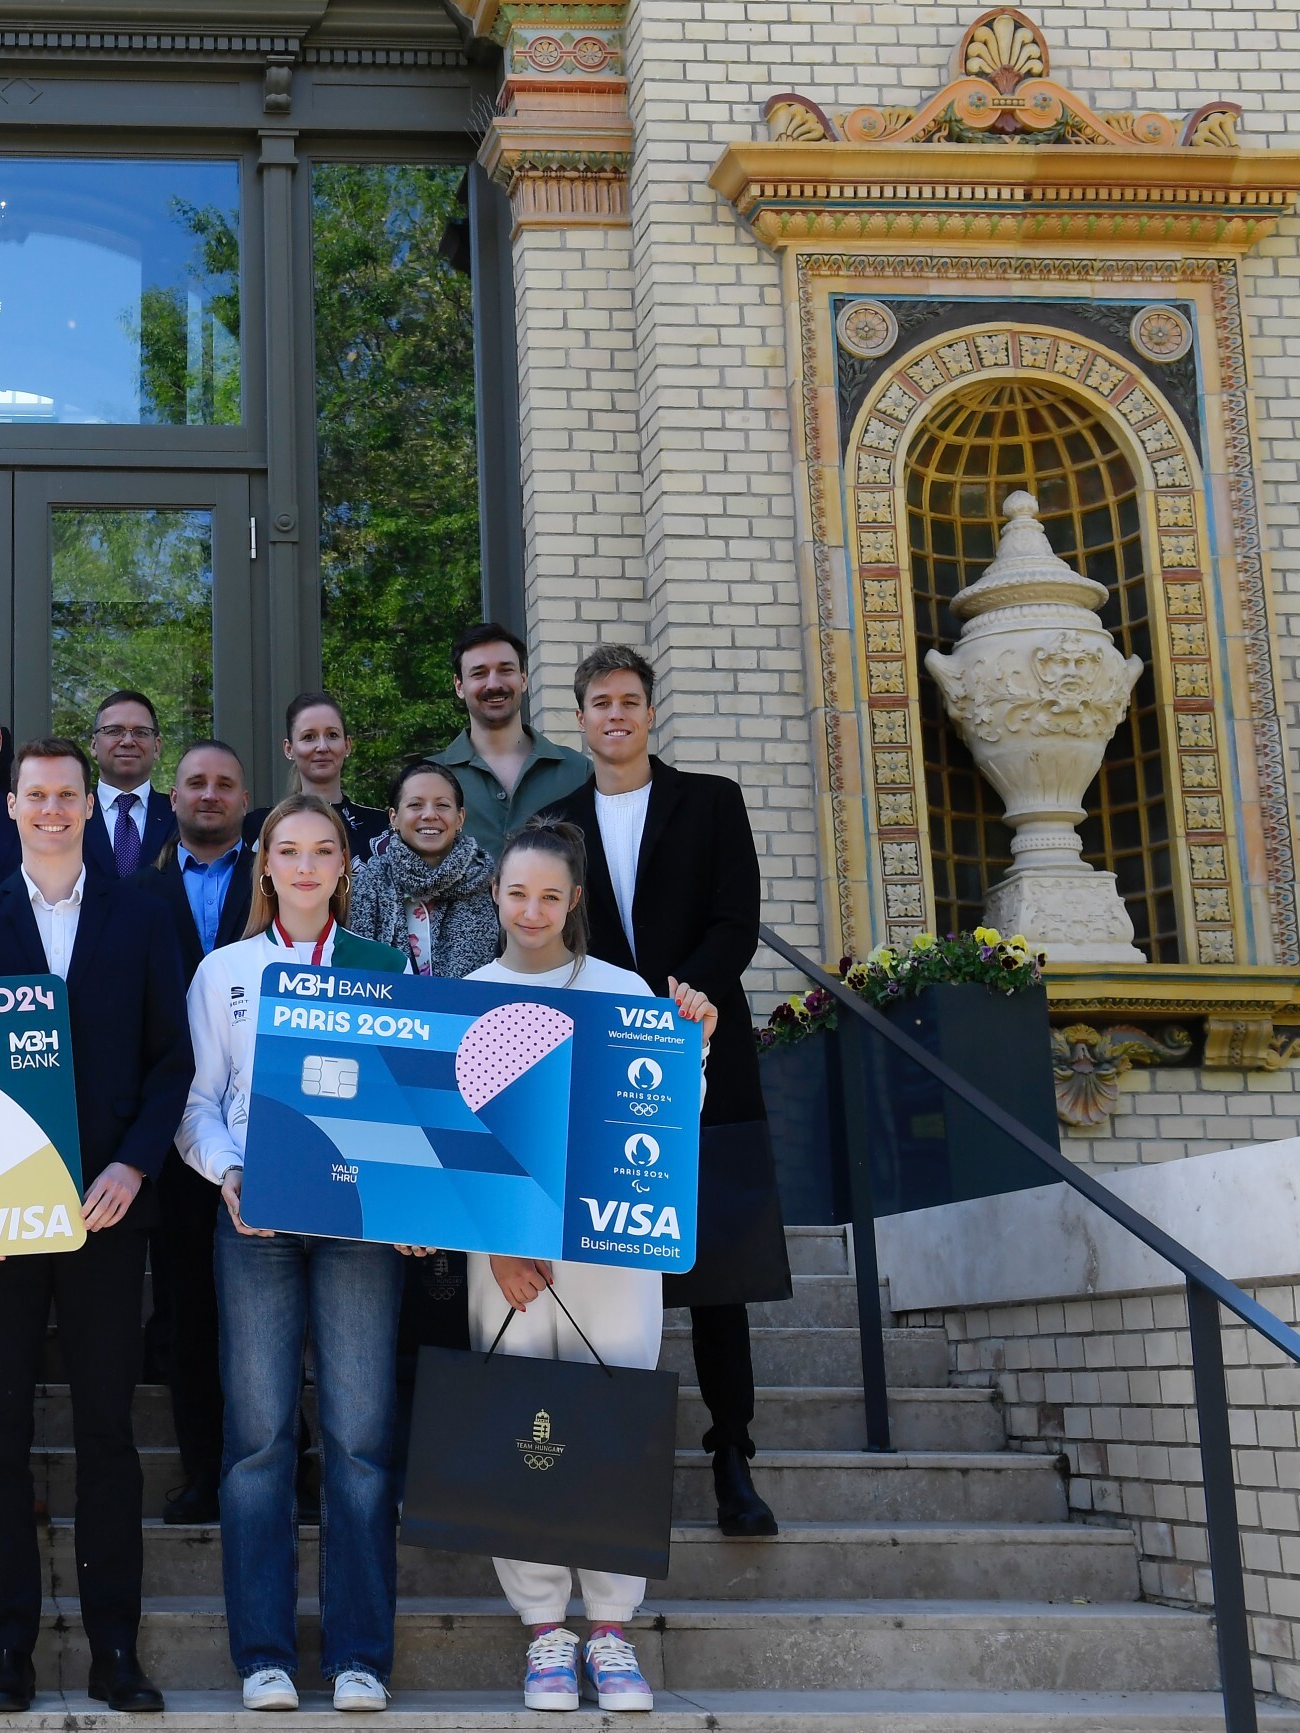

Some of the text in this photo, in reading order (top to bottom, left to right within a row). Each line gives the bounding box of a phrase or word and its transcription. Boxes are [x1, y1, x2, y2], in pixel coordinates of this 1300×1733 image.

[278, 971, 393, 1000] MBH BANK
[357, 1013, 430, 1041] 2024
[614, 1006, 675, 1031] VISA
[8, 1029, 60, 1053] MBH
[608, 1030, 685, 1045] Worldwide Partner
[10, 1052, 61, 1070] BANK
[646, 1093, 672, 1103] 2024
[331, 1163, 359, 1174] VALID
[331, 1172, 358, 1183] THRU
[643, 1170, 669, 1179] 2024
[579, 1197, 681, 1240] VISA
[581, 1236, 681, 1258] Business Debit
[516, 1442, 565, 1454] TEAM HUNGARY
